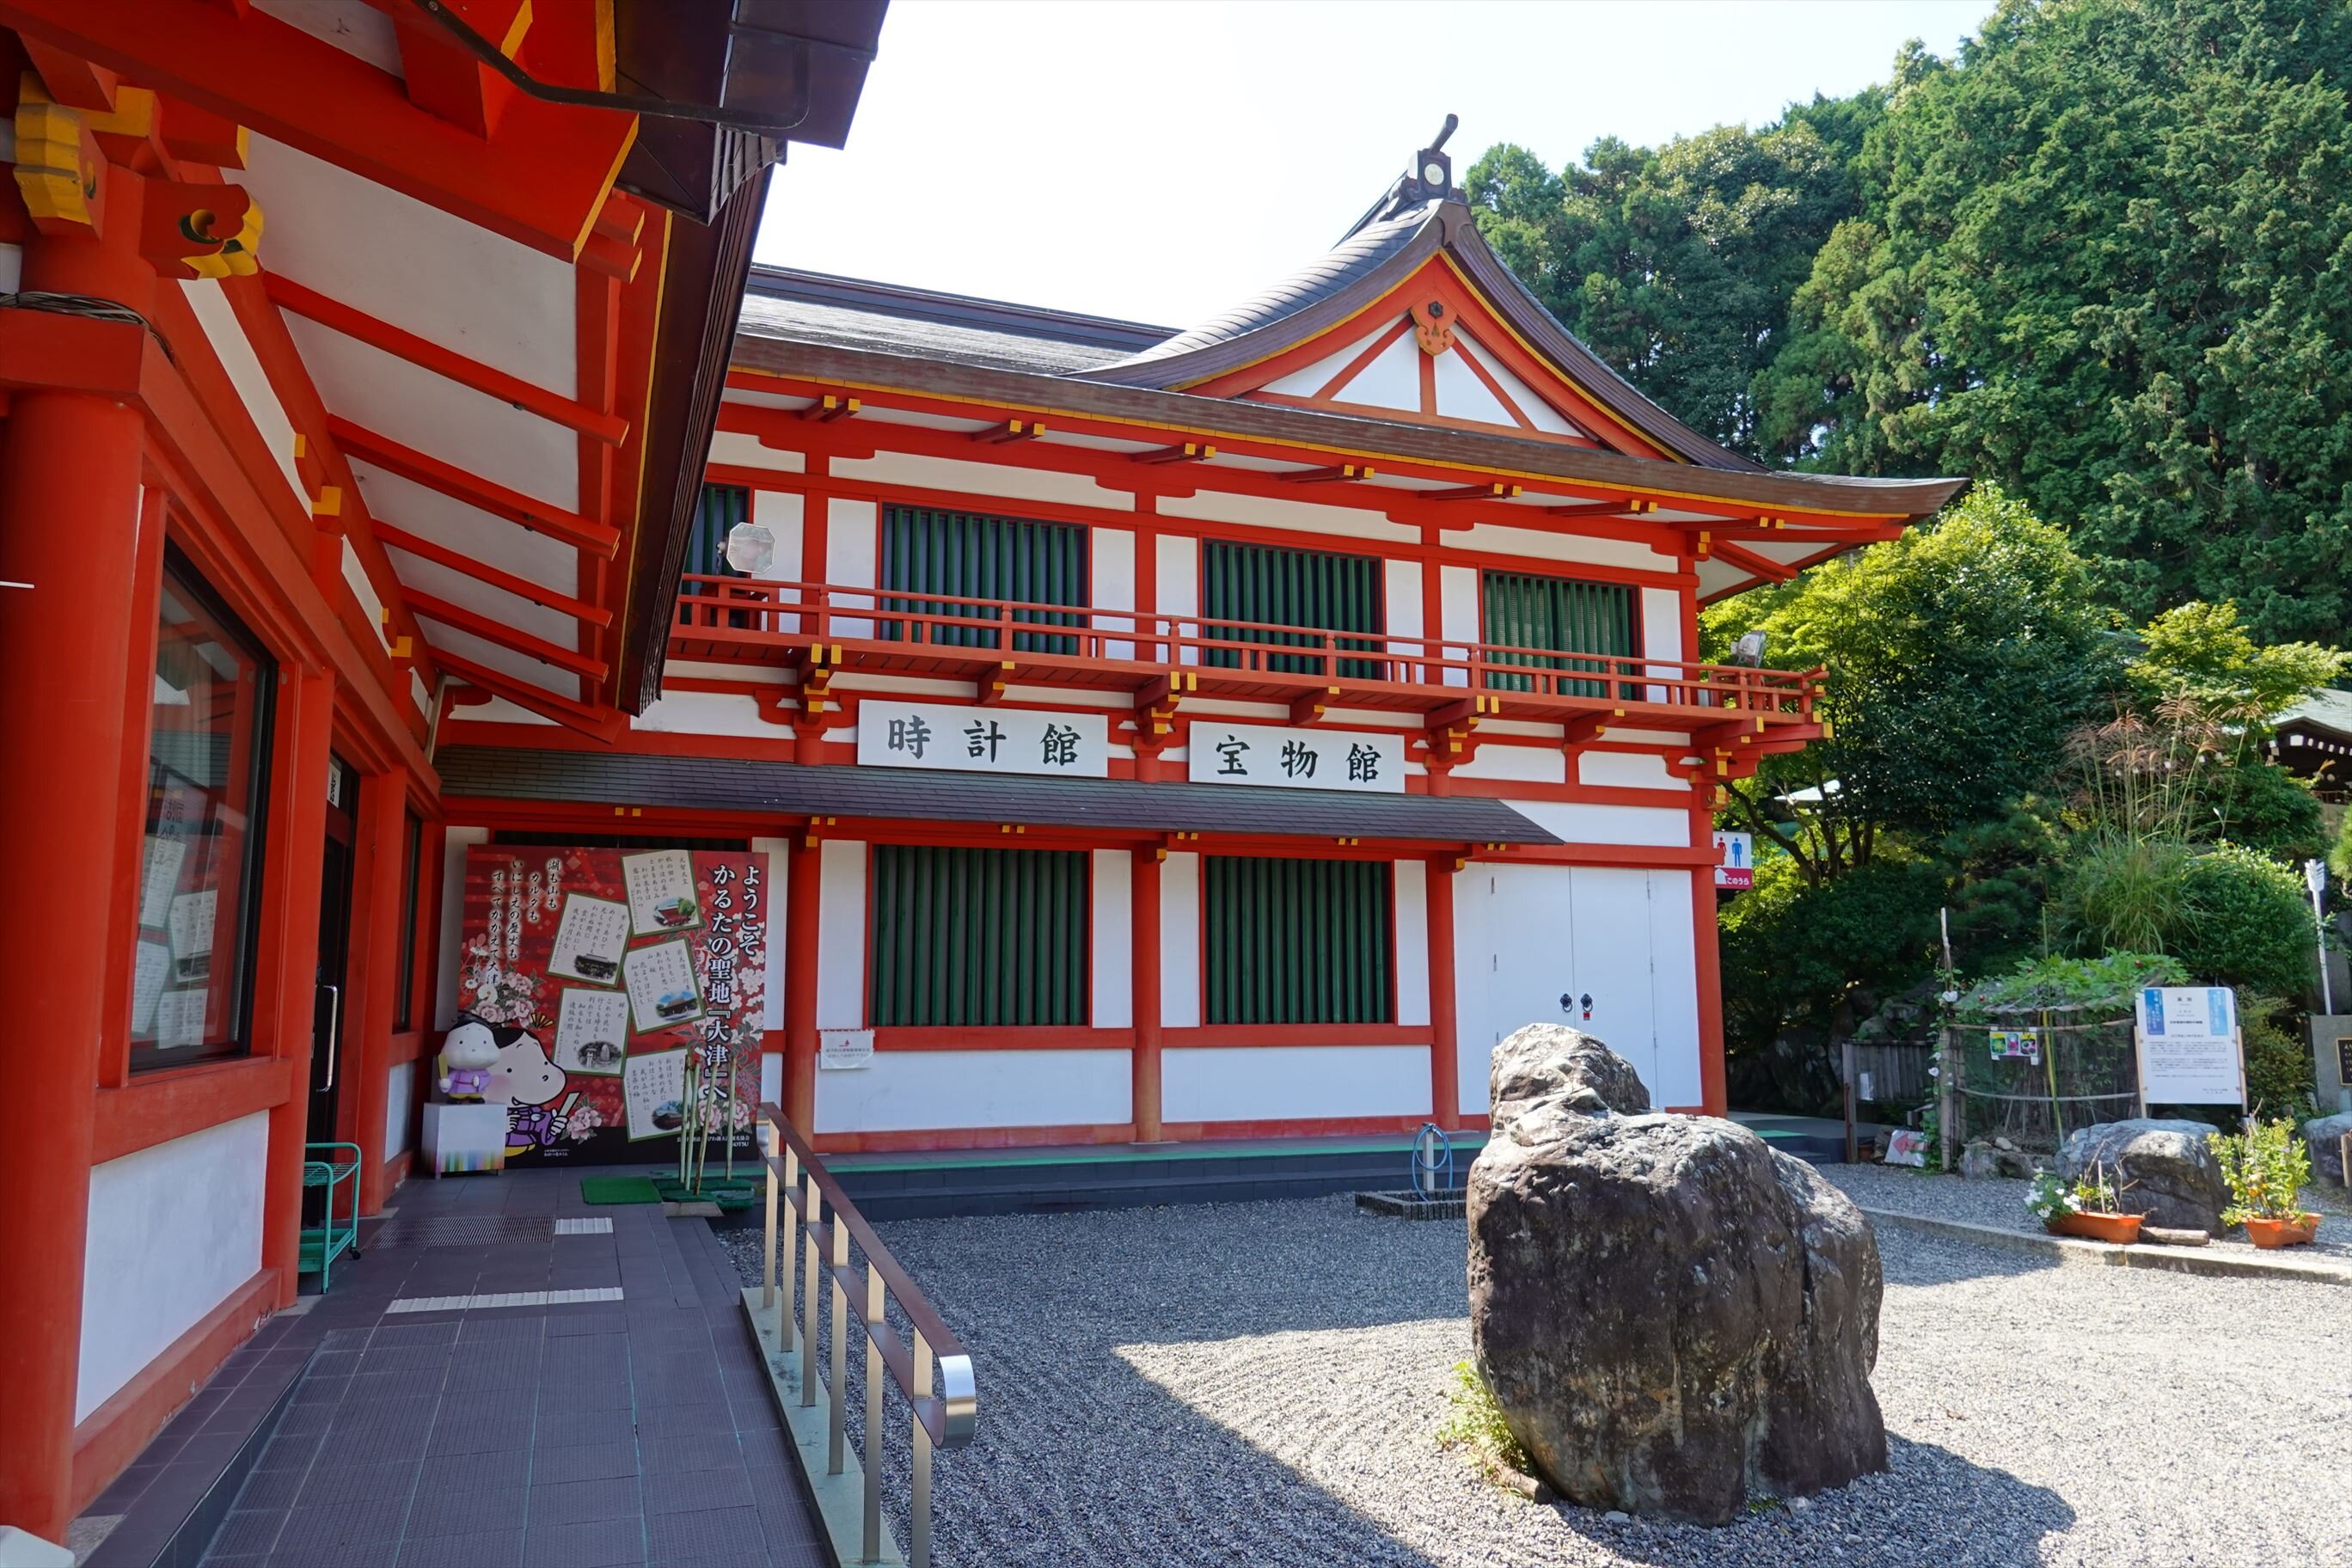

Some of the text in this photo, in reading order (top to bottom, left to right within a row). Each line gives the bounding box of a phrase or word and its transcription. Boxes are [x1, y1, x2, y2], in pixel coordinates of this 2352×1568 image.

[887, 714, 1081, 766] 時計館
[1216, 734, 1381, 783] 宝物館
[507, 861, 523, 959] いにしえの歴史も
[530, 873, 540, 921] カルタも
[547, 860, 560, 909] 湖も山も
[738, 865, 761, 956] ようこそ
[703, 864, 736, 1099] かるたの聖地『大津』へ
